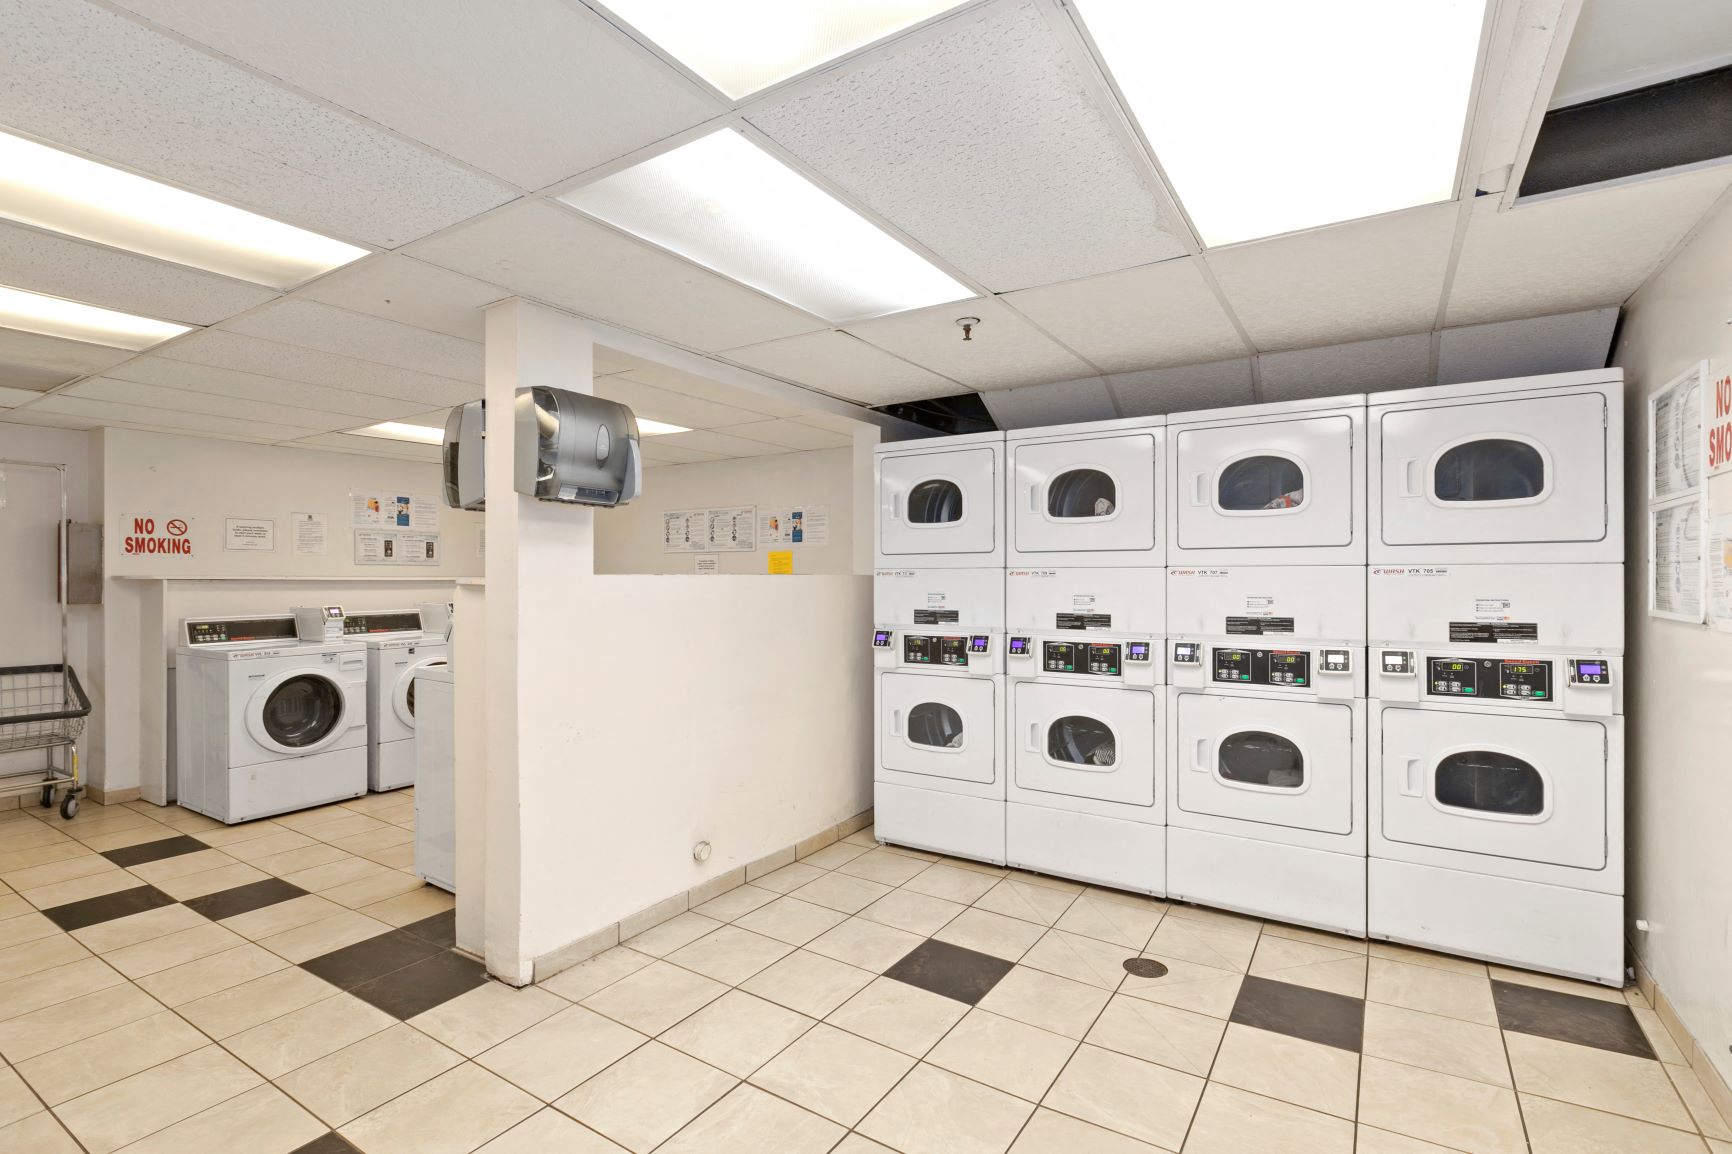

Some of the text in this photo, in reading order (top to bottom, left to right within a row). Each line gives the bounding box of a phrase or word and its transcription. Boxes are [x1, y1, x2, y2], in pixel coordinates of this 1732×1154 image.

[1716, 375, 1731, 418] NO
[134, 518, 155, 535] NO
[125, 536, 191, 555] SMOKING
